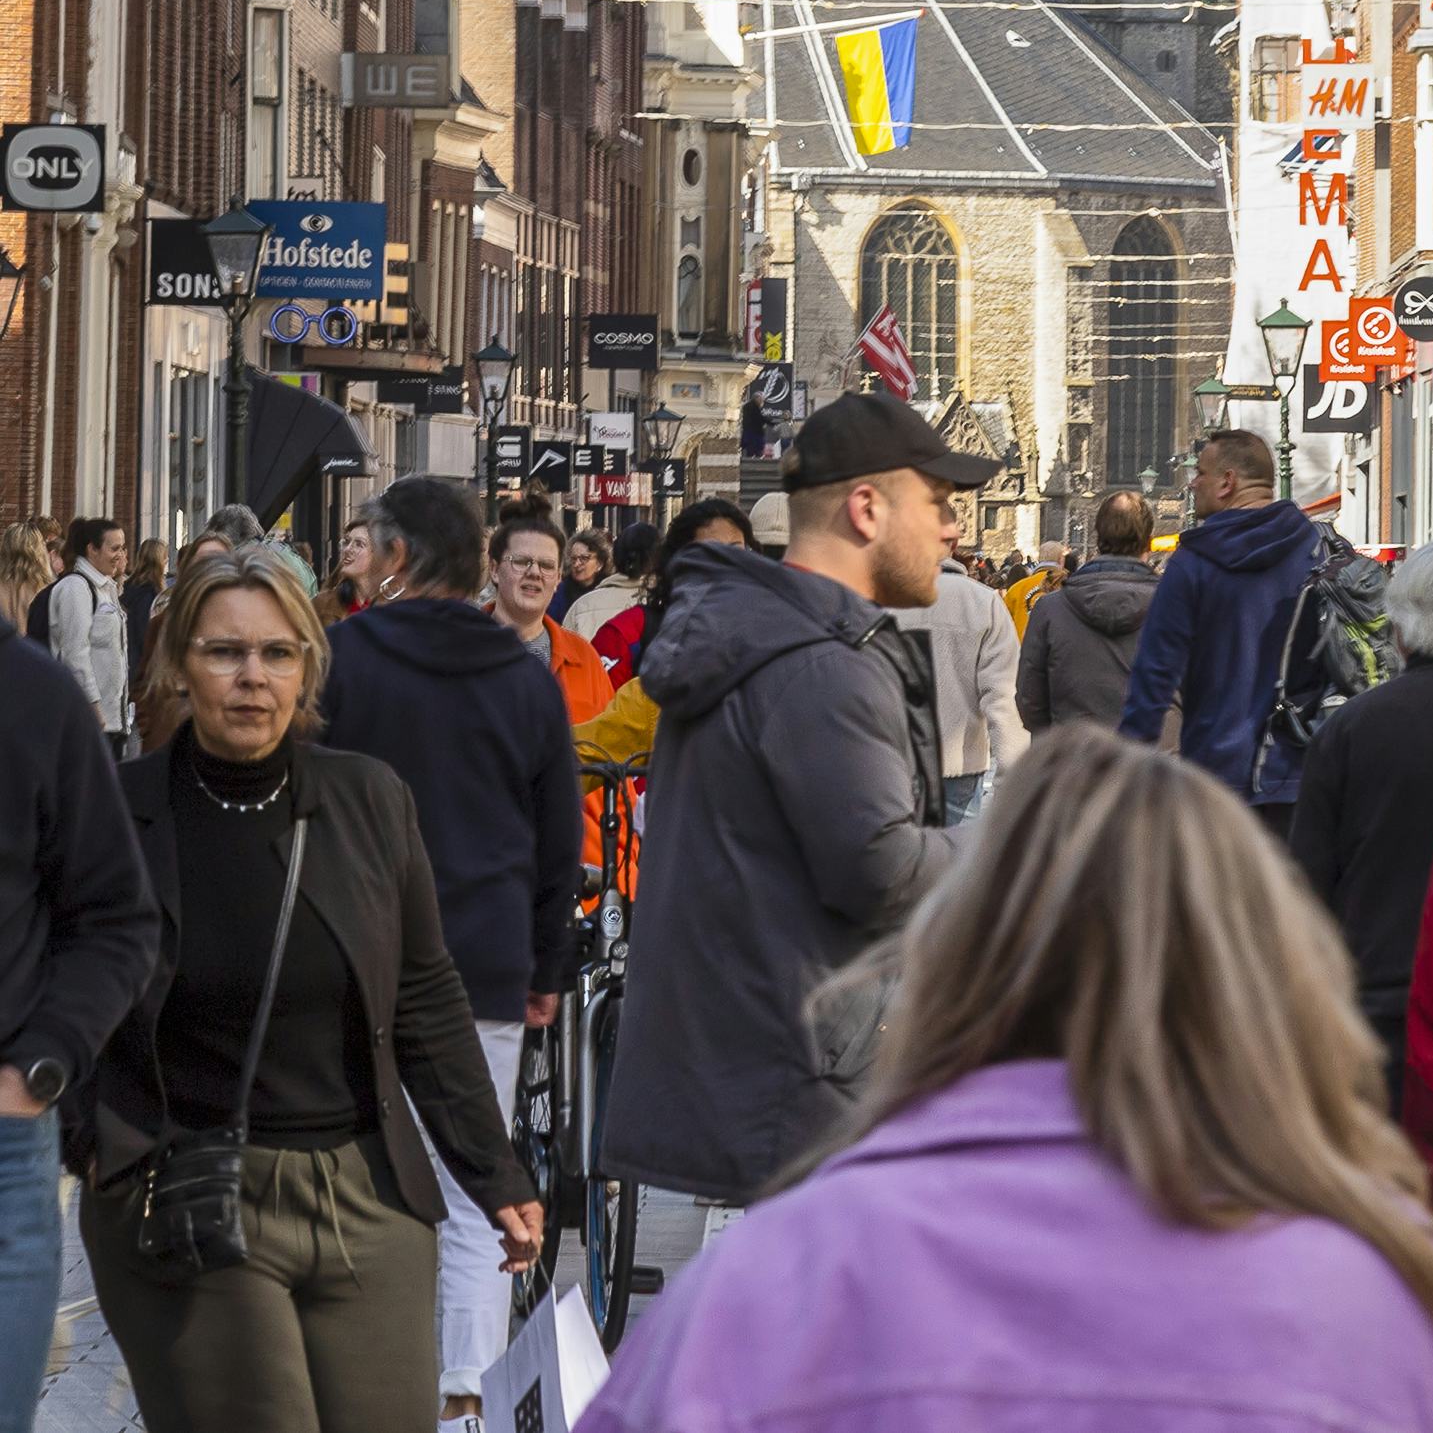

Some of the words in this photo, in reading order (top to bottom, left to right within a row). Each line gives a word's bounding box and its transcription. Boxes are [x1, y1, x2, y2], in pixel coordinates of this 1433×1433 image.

[366, 64, 438, 96] WE
[1308, 77, 1369, 117] H&M
[12, 157, 93, 179] ONLY
[261, 237, 373, 269] Hofstede
[593, 332, 654, 345] COSMO
[1306, 380, 1369, 420] JD
